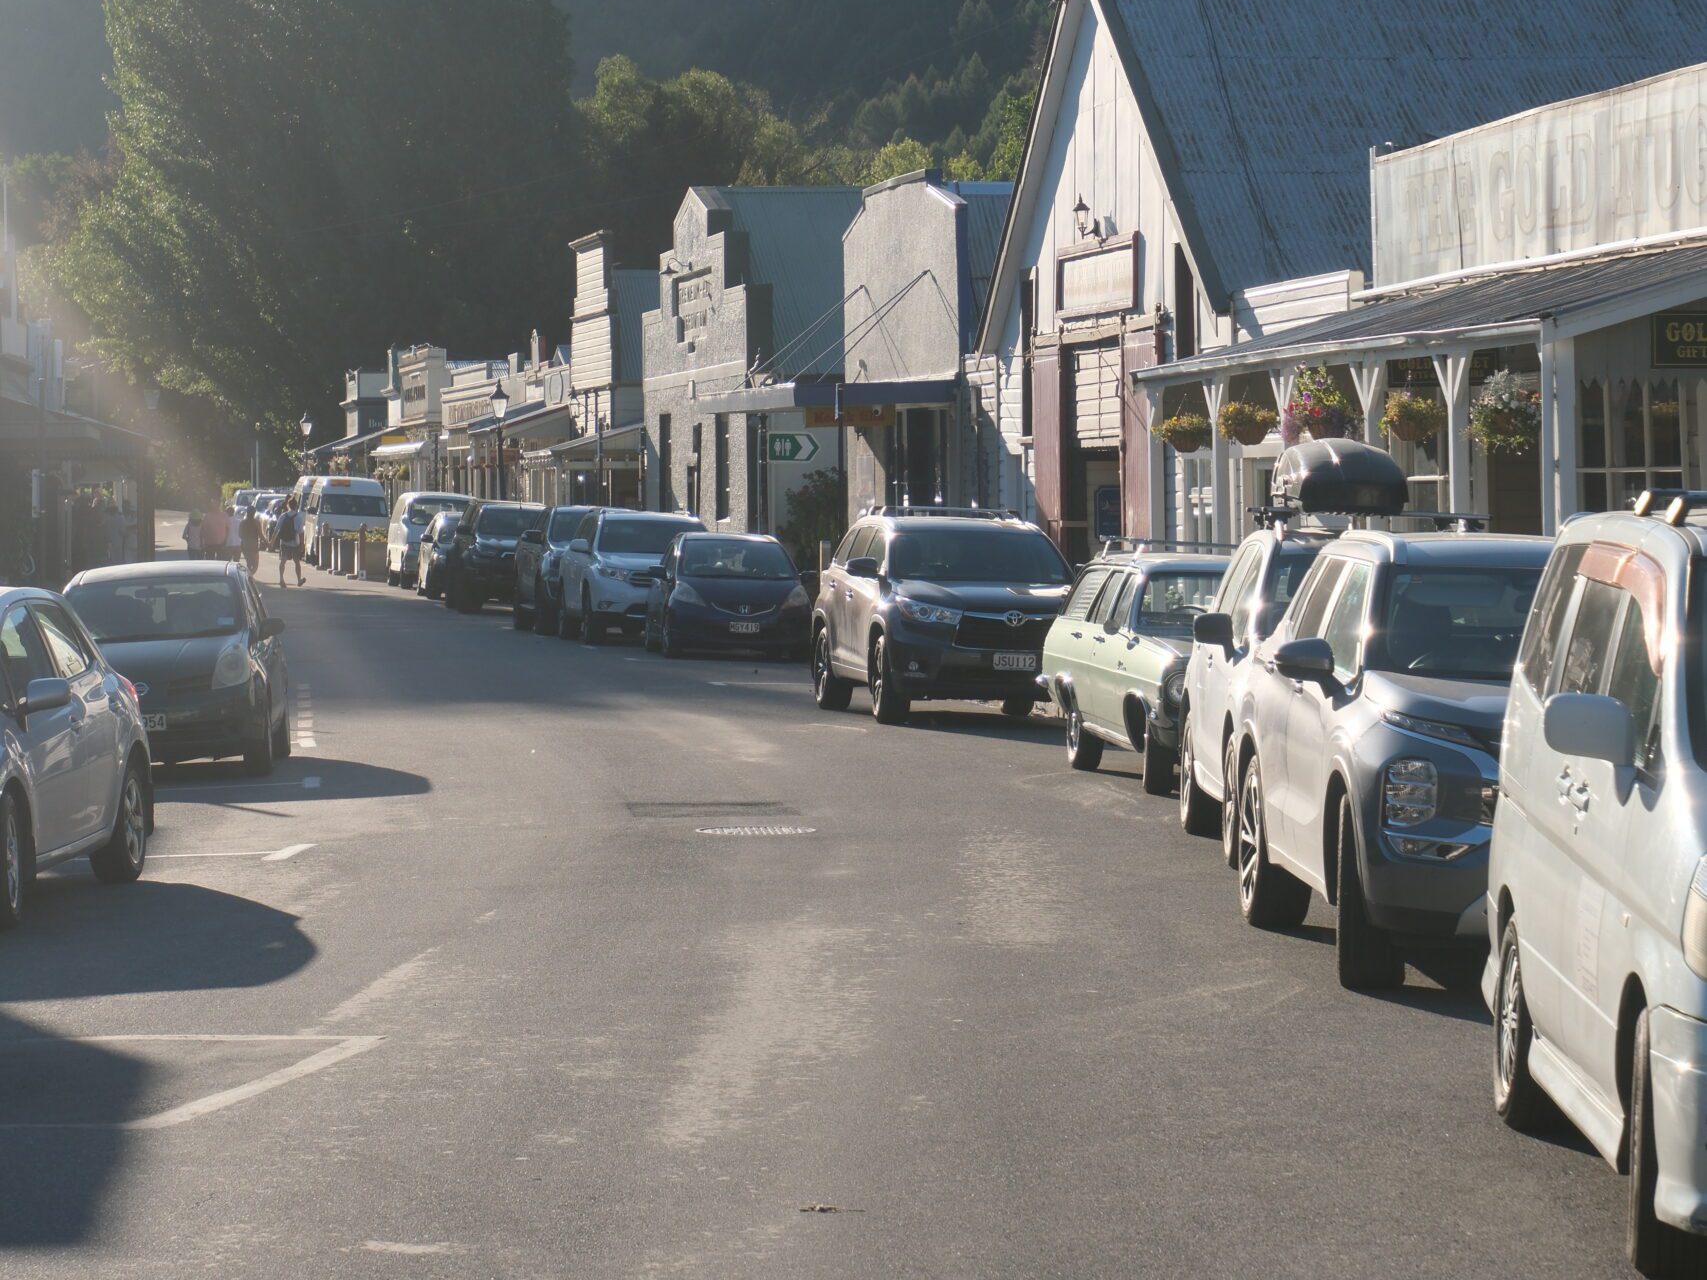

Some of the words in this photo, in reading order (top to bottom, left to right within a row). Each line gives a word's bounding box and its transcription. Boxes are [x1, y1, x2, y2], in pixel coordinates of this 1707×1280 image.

[1403, 162, 1476, 256] THE
[1489, 132, 1595, 242] GOLD
[1398, 357, 1432, 370] GOLD
[995, 656, 1035, 668] JSU112
